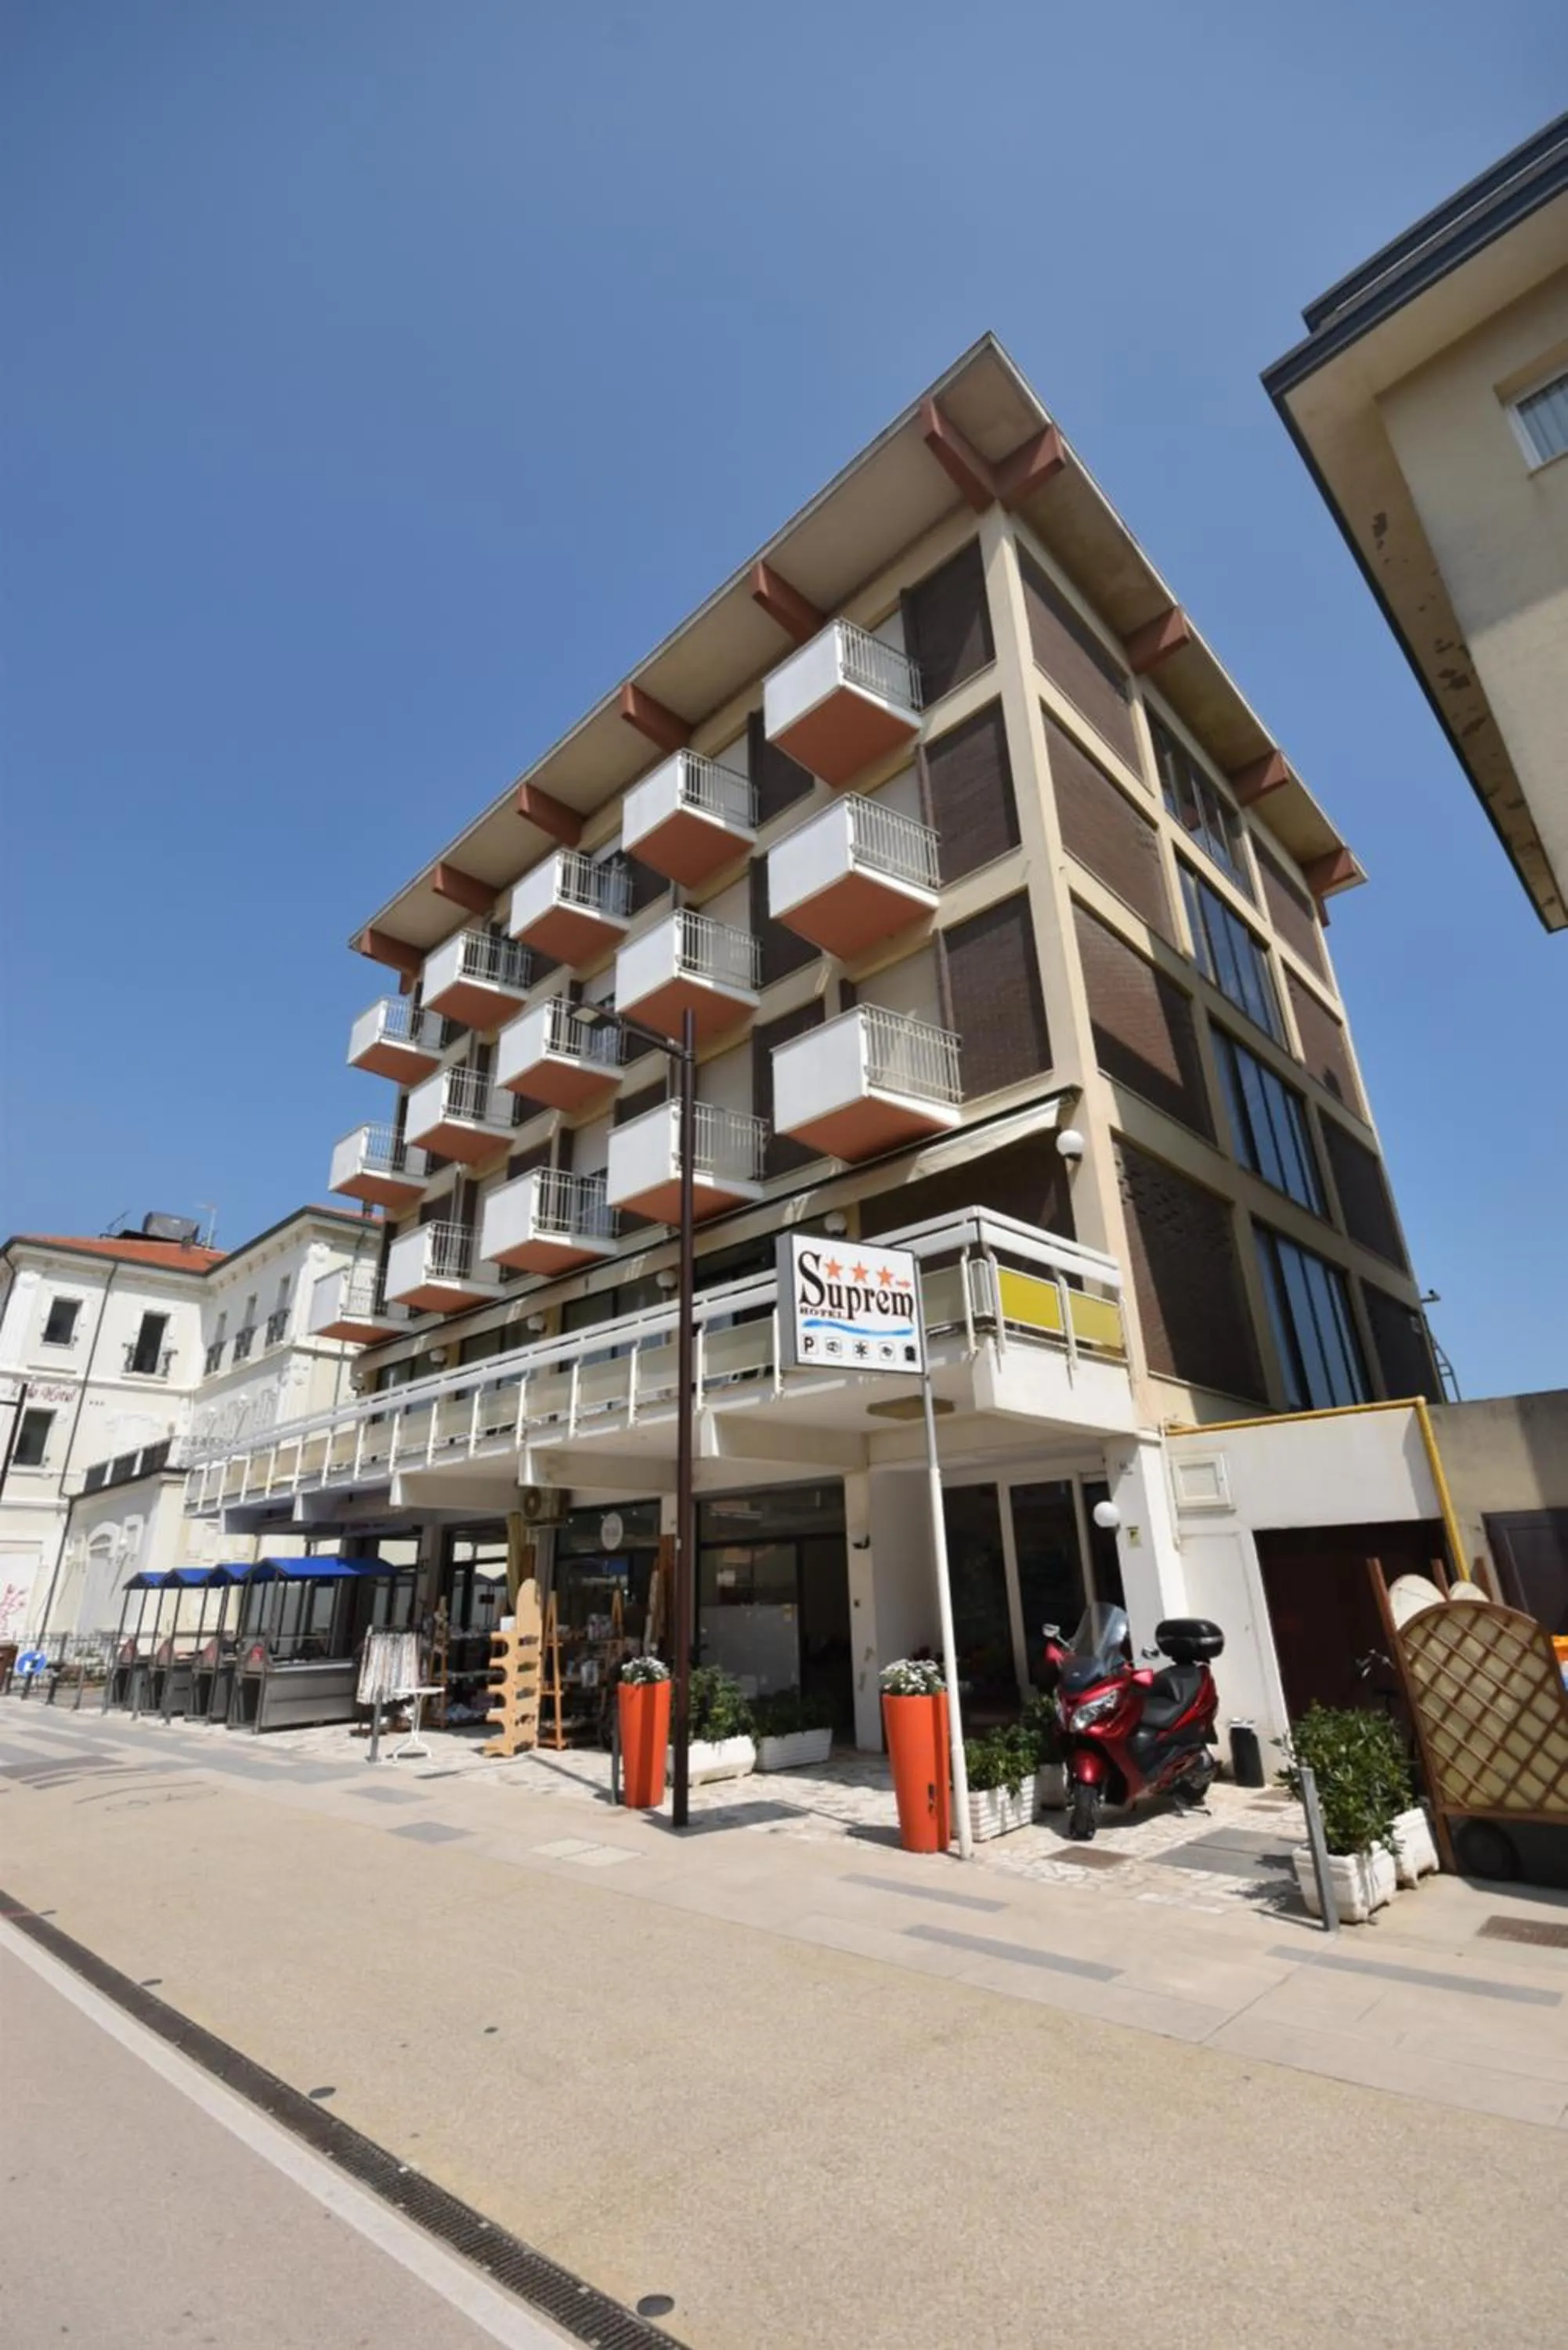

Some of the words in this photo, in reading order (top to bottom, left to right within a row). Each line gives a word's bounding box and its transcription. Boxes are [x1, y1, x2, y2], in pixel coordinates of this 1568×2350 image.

[798, 1251, 914, 1323] Suprem
[800, 1307, 845, 1319] HOTEL
[804, 1336, 815, 1354] P
